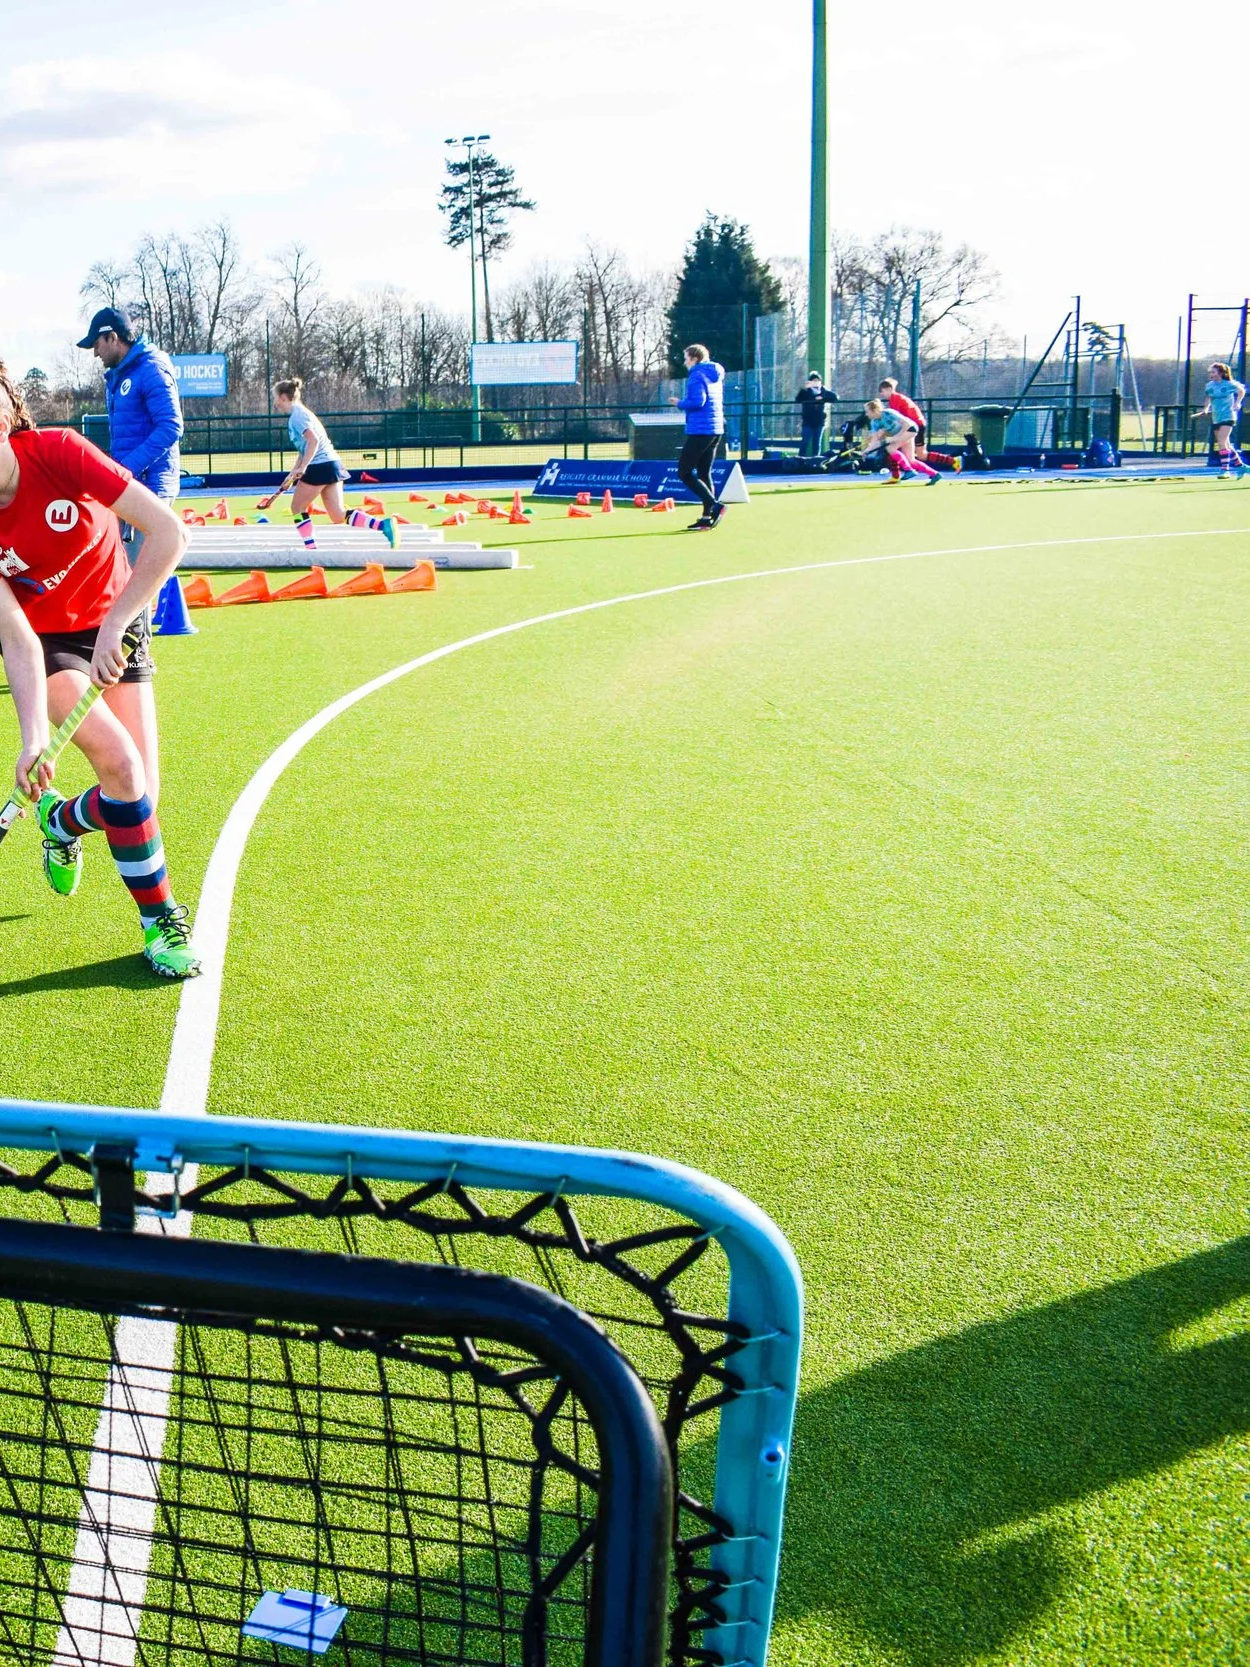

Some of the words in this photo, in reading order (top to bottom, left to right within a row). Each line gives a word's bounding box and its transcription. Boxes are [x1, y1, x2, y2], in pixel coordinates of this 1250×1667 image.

[183, 364, 224, 379] HOCKEY
[621, 475, 651, 483] SCHOOL
[42, 569, 68, 591] EVO
